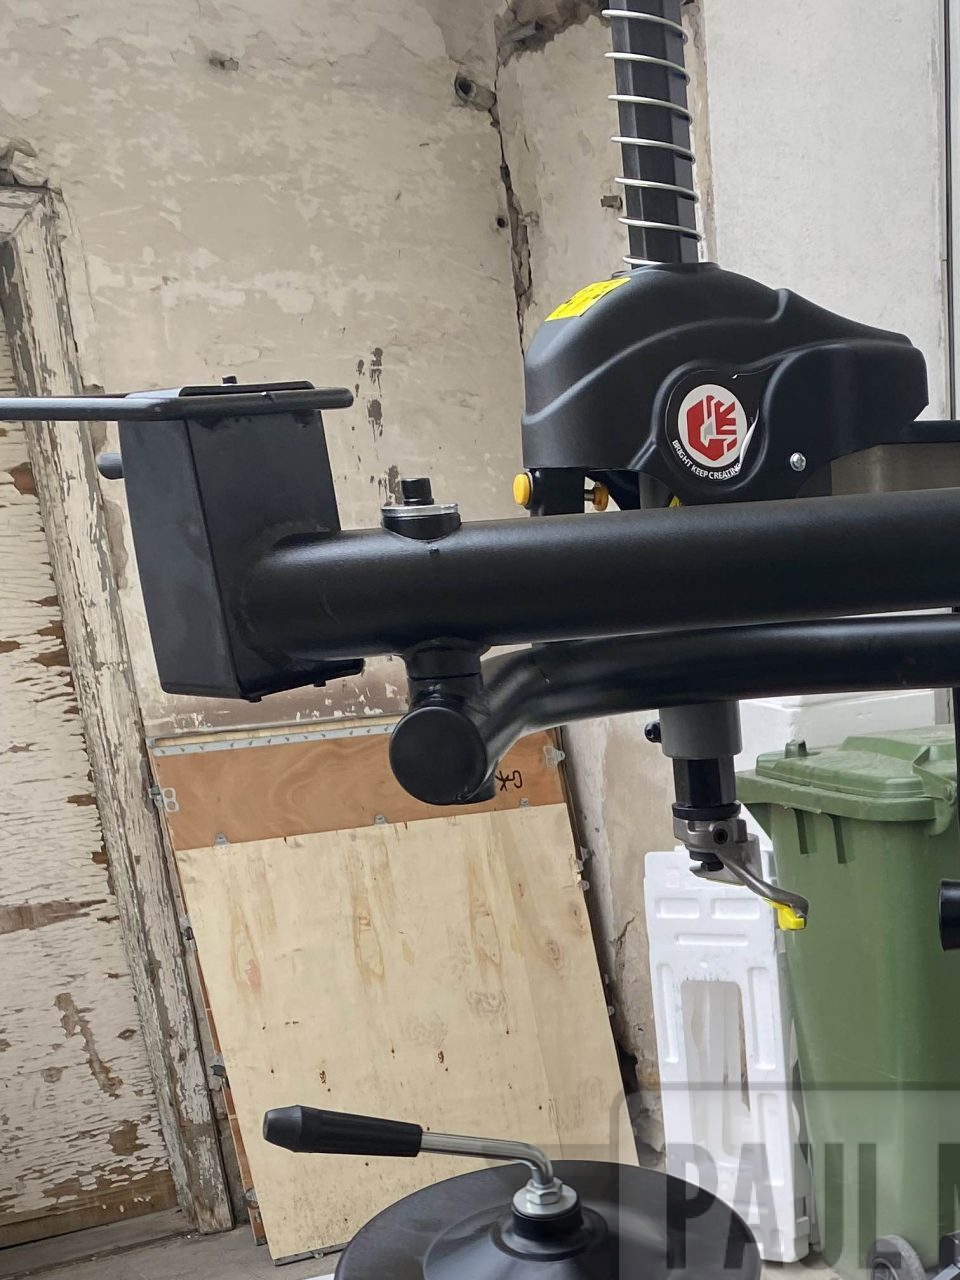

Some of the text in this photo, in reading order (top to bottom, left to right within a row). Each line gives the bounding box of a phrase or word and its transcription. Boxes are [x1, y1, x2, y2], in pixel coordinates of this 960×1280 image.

[672, 440, 741, 480] BRIGHT KEEP CREATING
